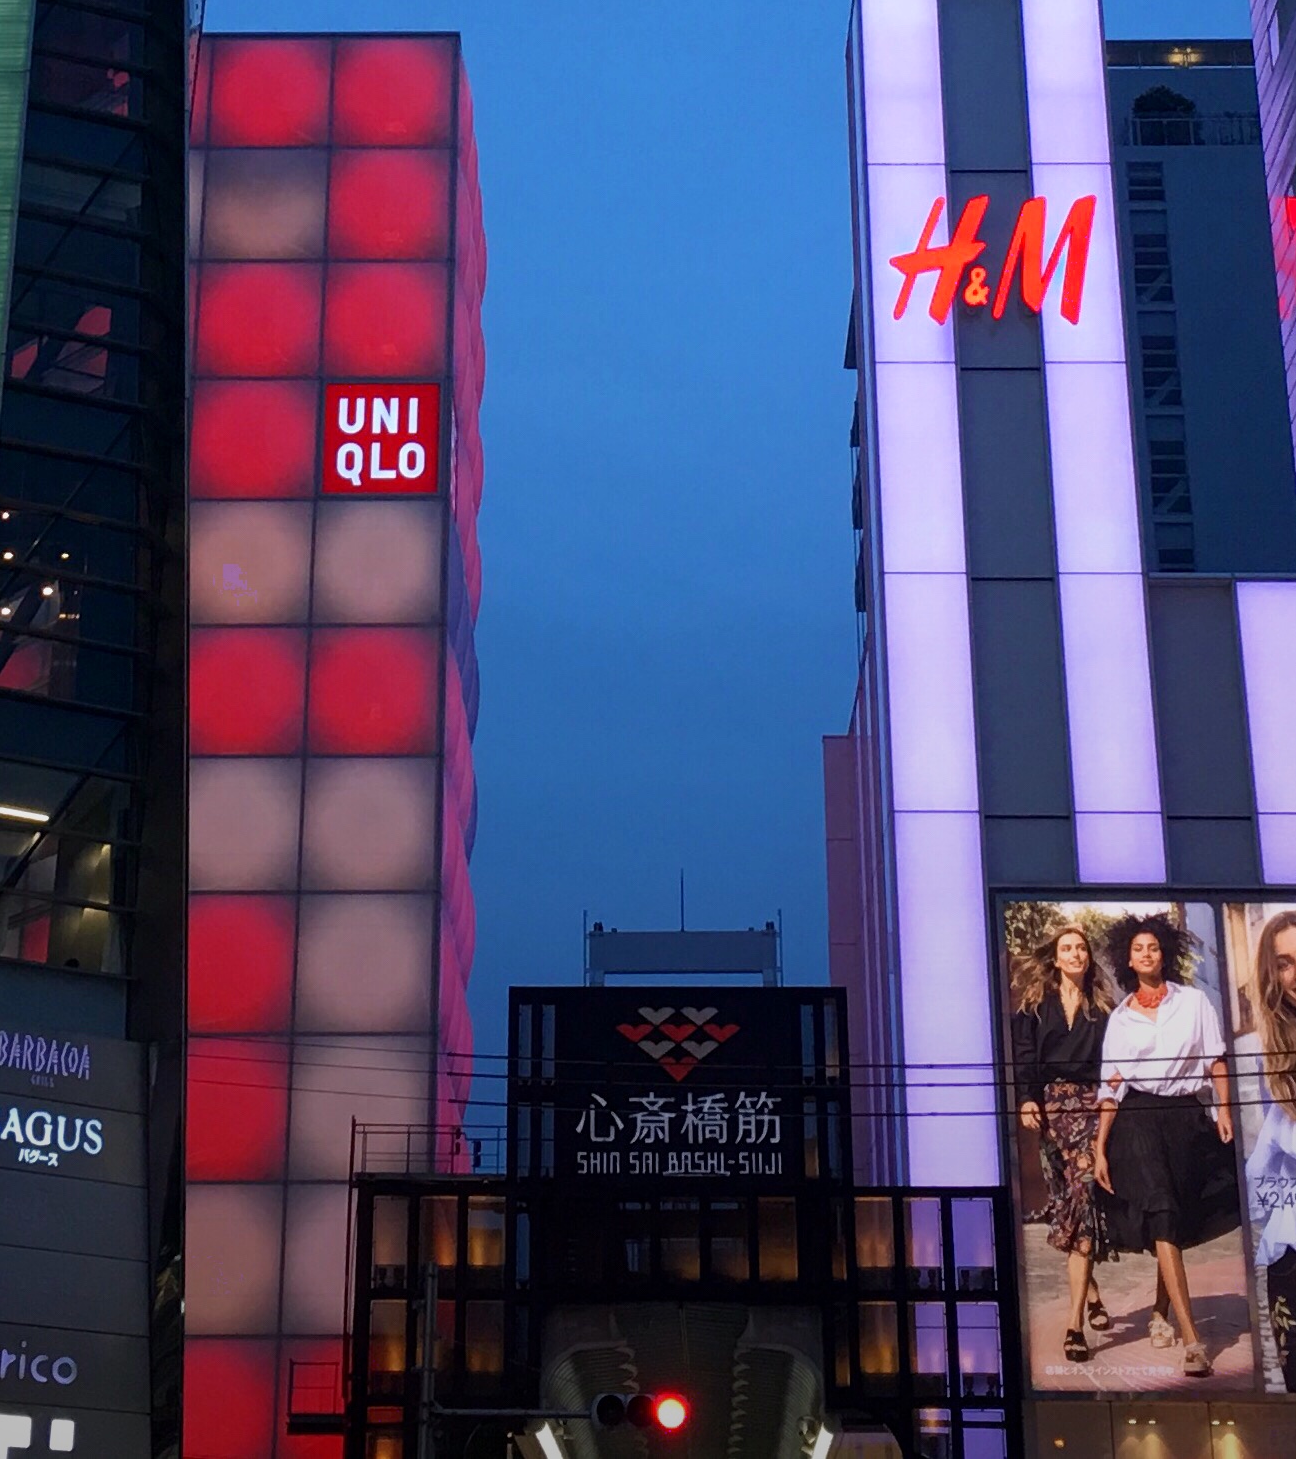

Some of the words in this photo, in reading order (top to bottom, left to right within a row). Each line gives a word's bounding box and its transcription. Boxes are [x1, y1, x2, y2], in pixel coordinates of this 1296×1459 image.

[889, 194, 1097, 325] H&M
[337, 397, 419, 434] UNI
[335, 442, 426, 486] QLO
[575, 1091, 782, 1144] 心斎橋筋
[18, 1148, 59, 1167] バグース
